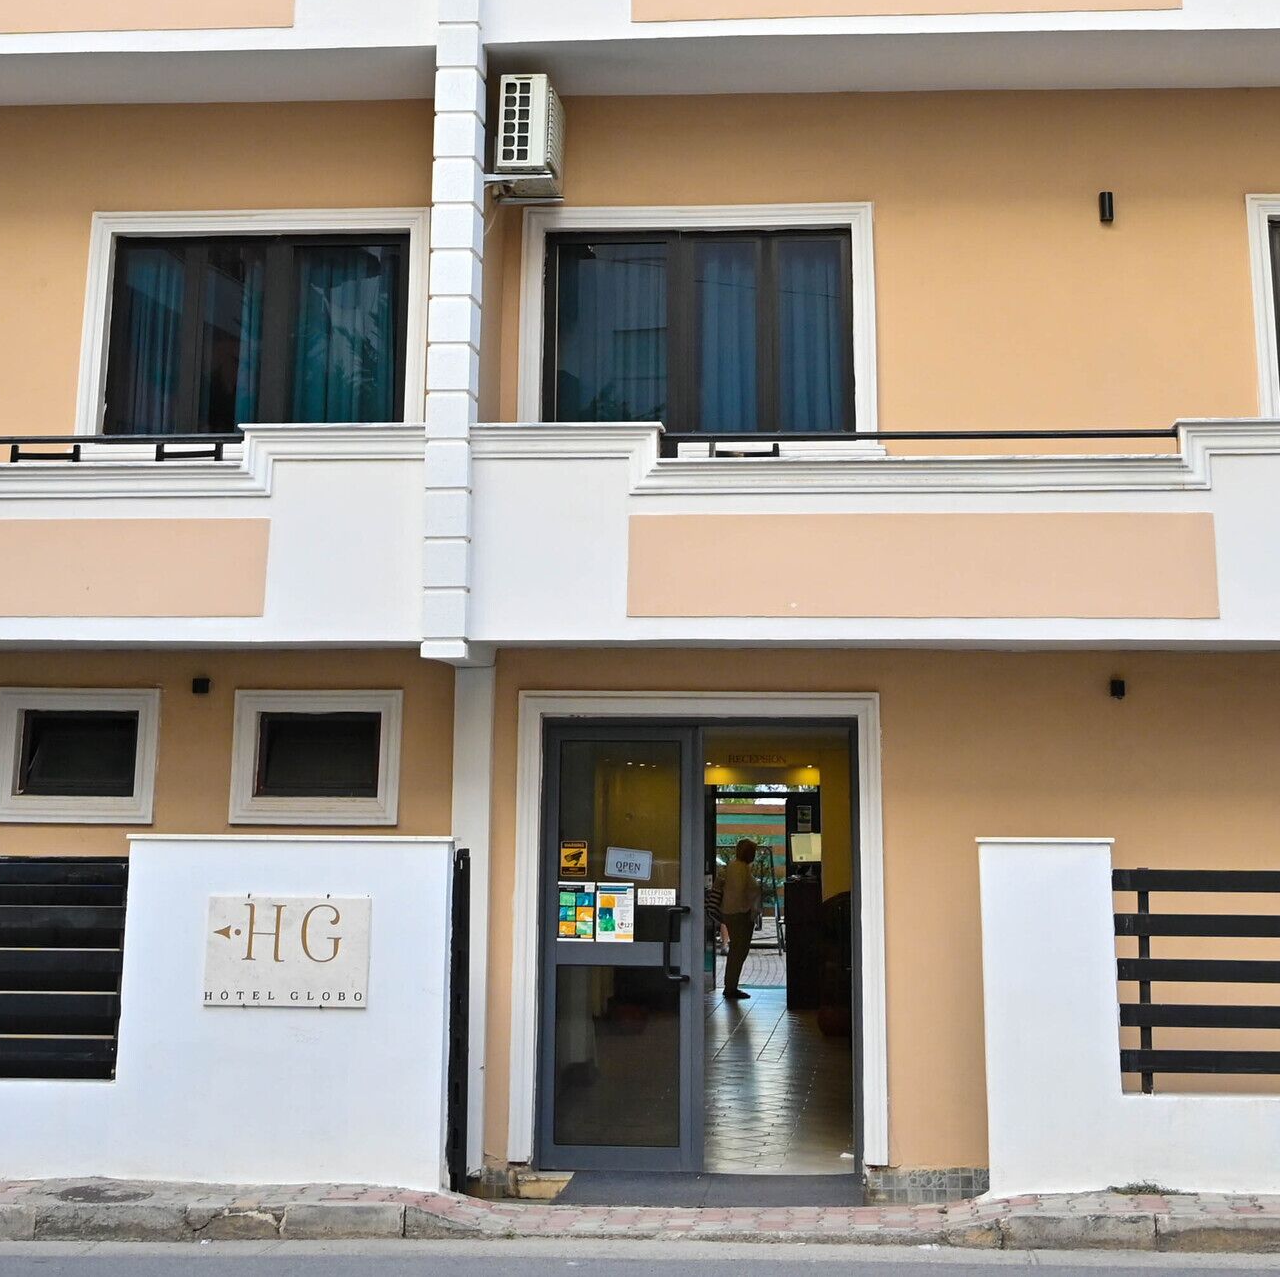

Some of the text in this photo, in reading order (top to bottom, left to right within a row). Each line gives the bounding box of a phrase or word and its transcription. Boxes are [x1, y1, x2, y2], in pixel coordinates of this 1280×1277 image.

[615, 860, 641, 872] OPEN
[241, 902, 342, 963] HG
[204, 991, 363, 1002] HOTEL GLOBO
